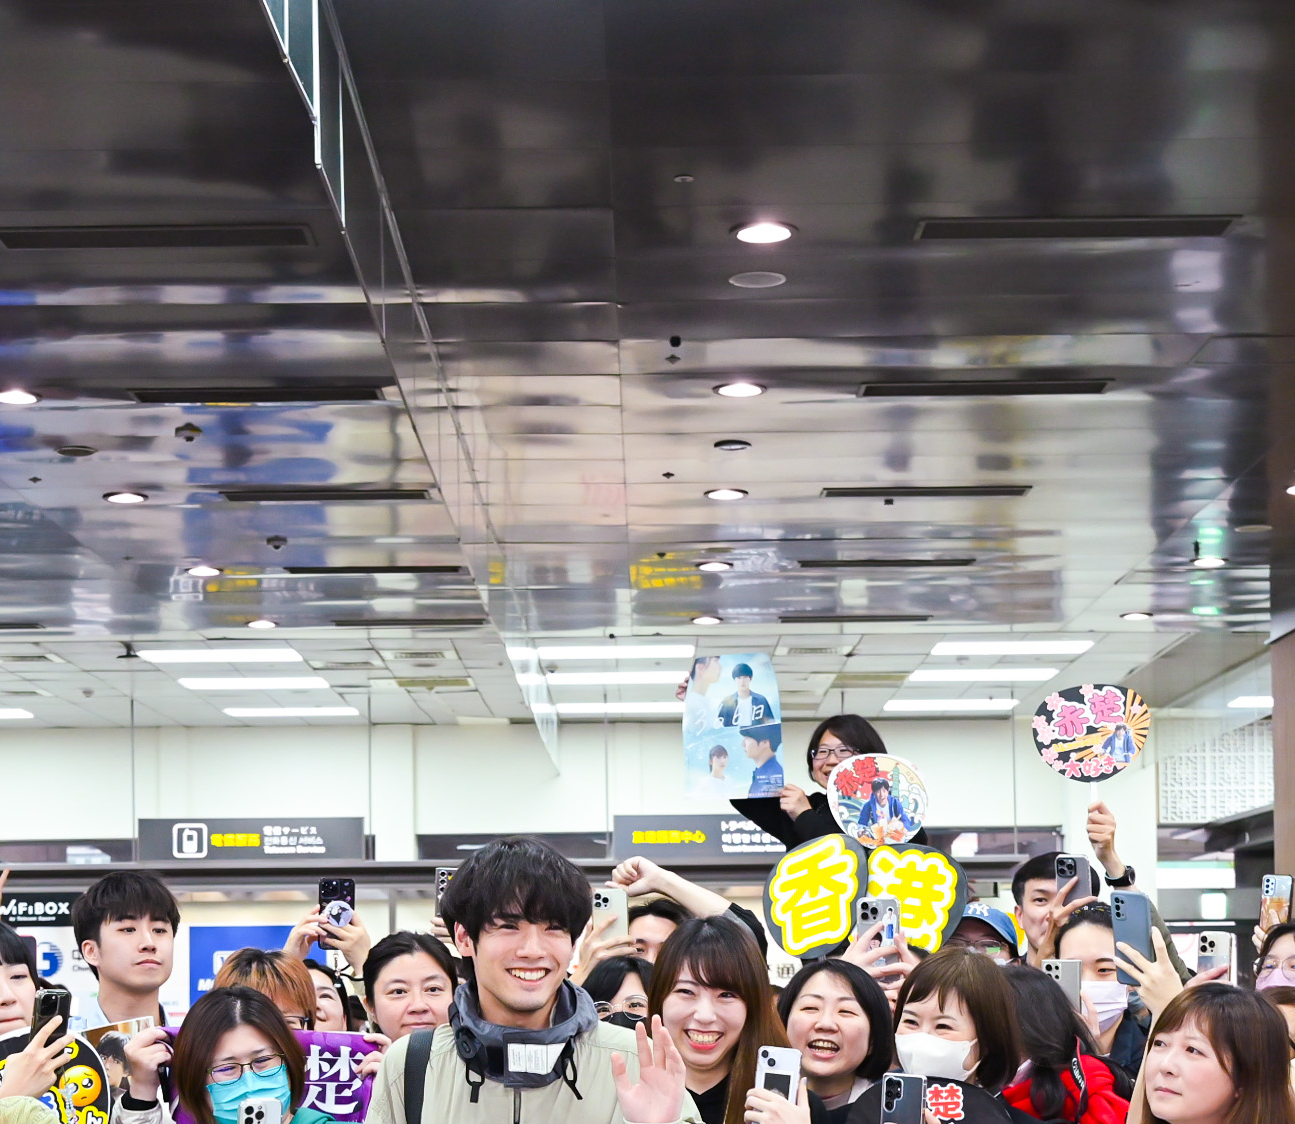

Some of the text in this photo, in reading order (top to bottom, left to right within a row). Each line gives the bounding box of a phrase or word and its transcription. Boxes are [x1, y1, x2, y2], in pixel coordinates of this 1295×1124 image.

[1054, 690, 1124, 738] 赤楚
[1065, 755, 1116, 777] 大好き
[774, 841, 951, 950] 香港
[303, 1044, 365, 1115] 楚
